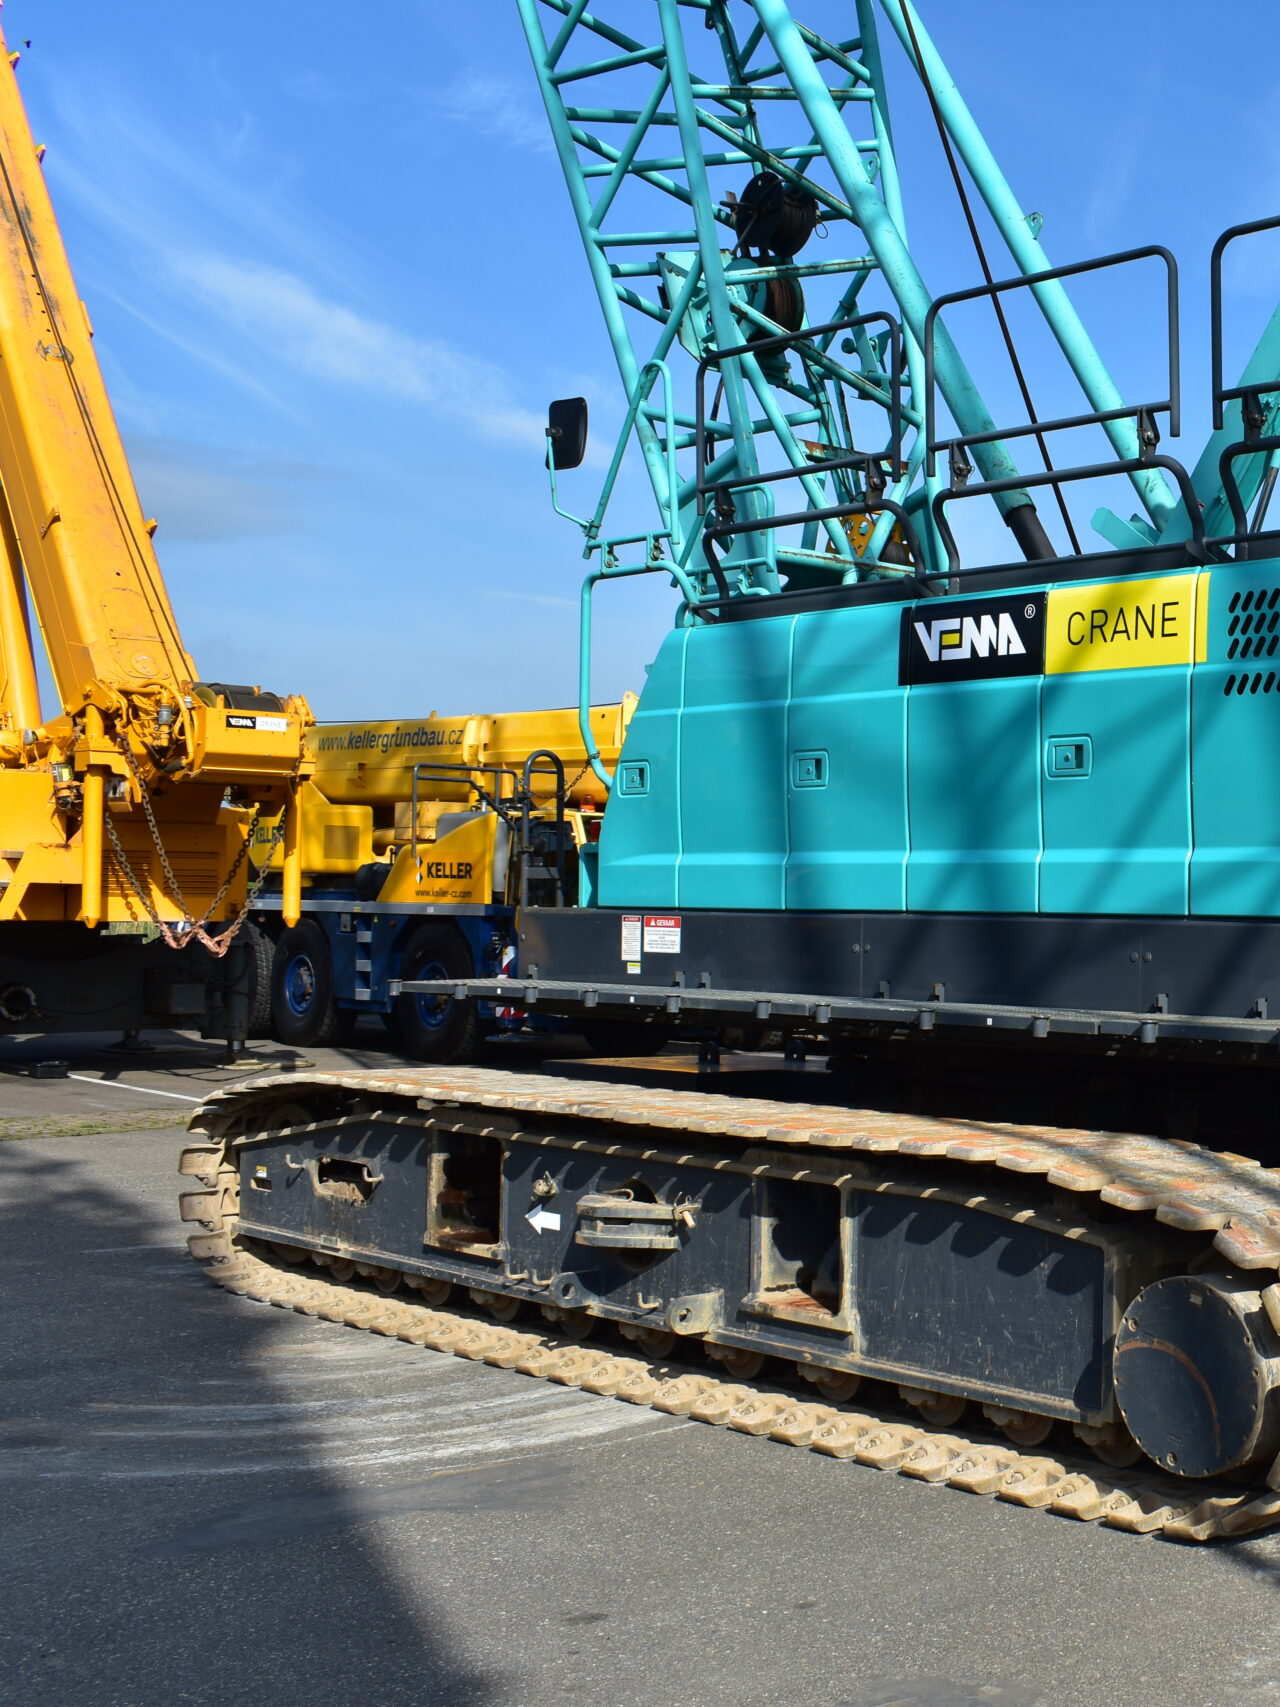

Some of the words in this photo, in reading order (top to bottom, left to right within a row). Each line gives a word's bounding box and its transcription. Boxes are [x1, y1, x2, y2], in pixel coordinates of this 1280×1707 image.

[913, 613, 1027, 662] VEMA
[1067, 602, 1179, 646] CRANE
[427, 862, 472, 879] KELLER
[415, 887, 472, 898] www.keller-cz.com
